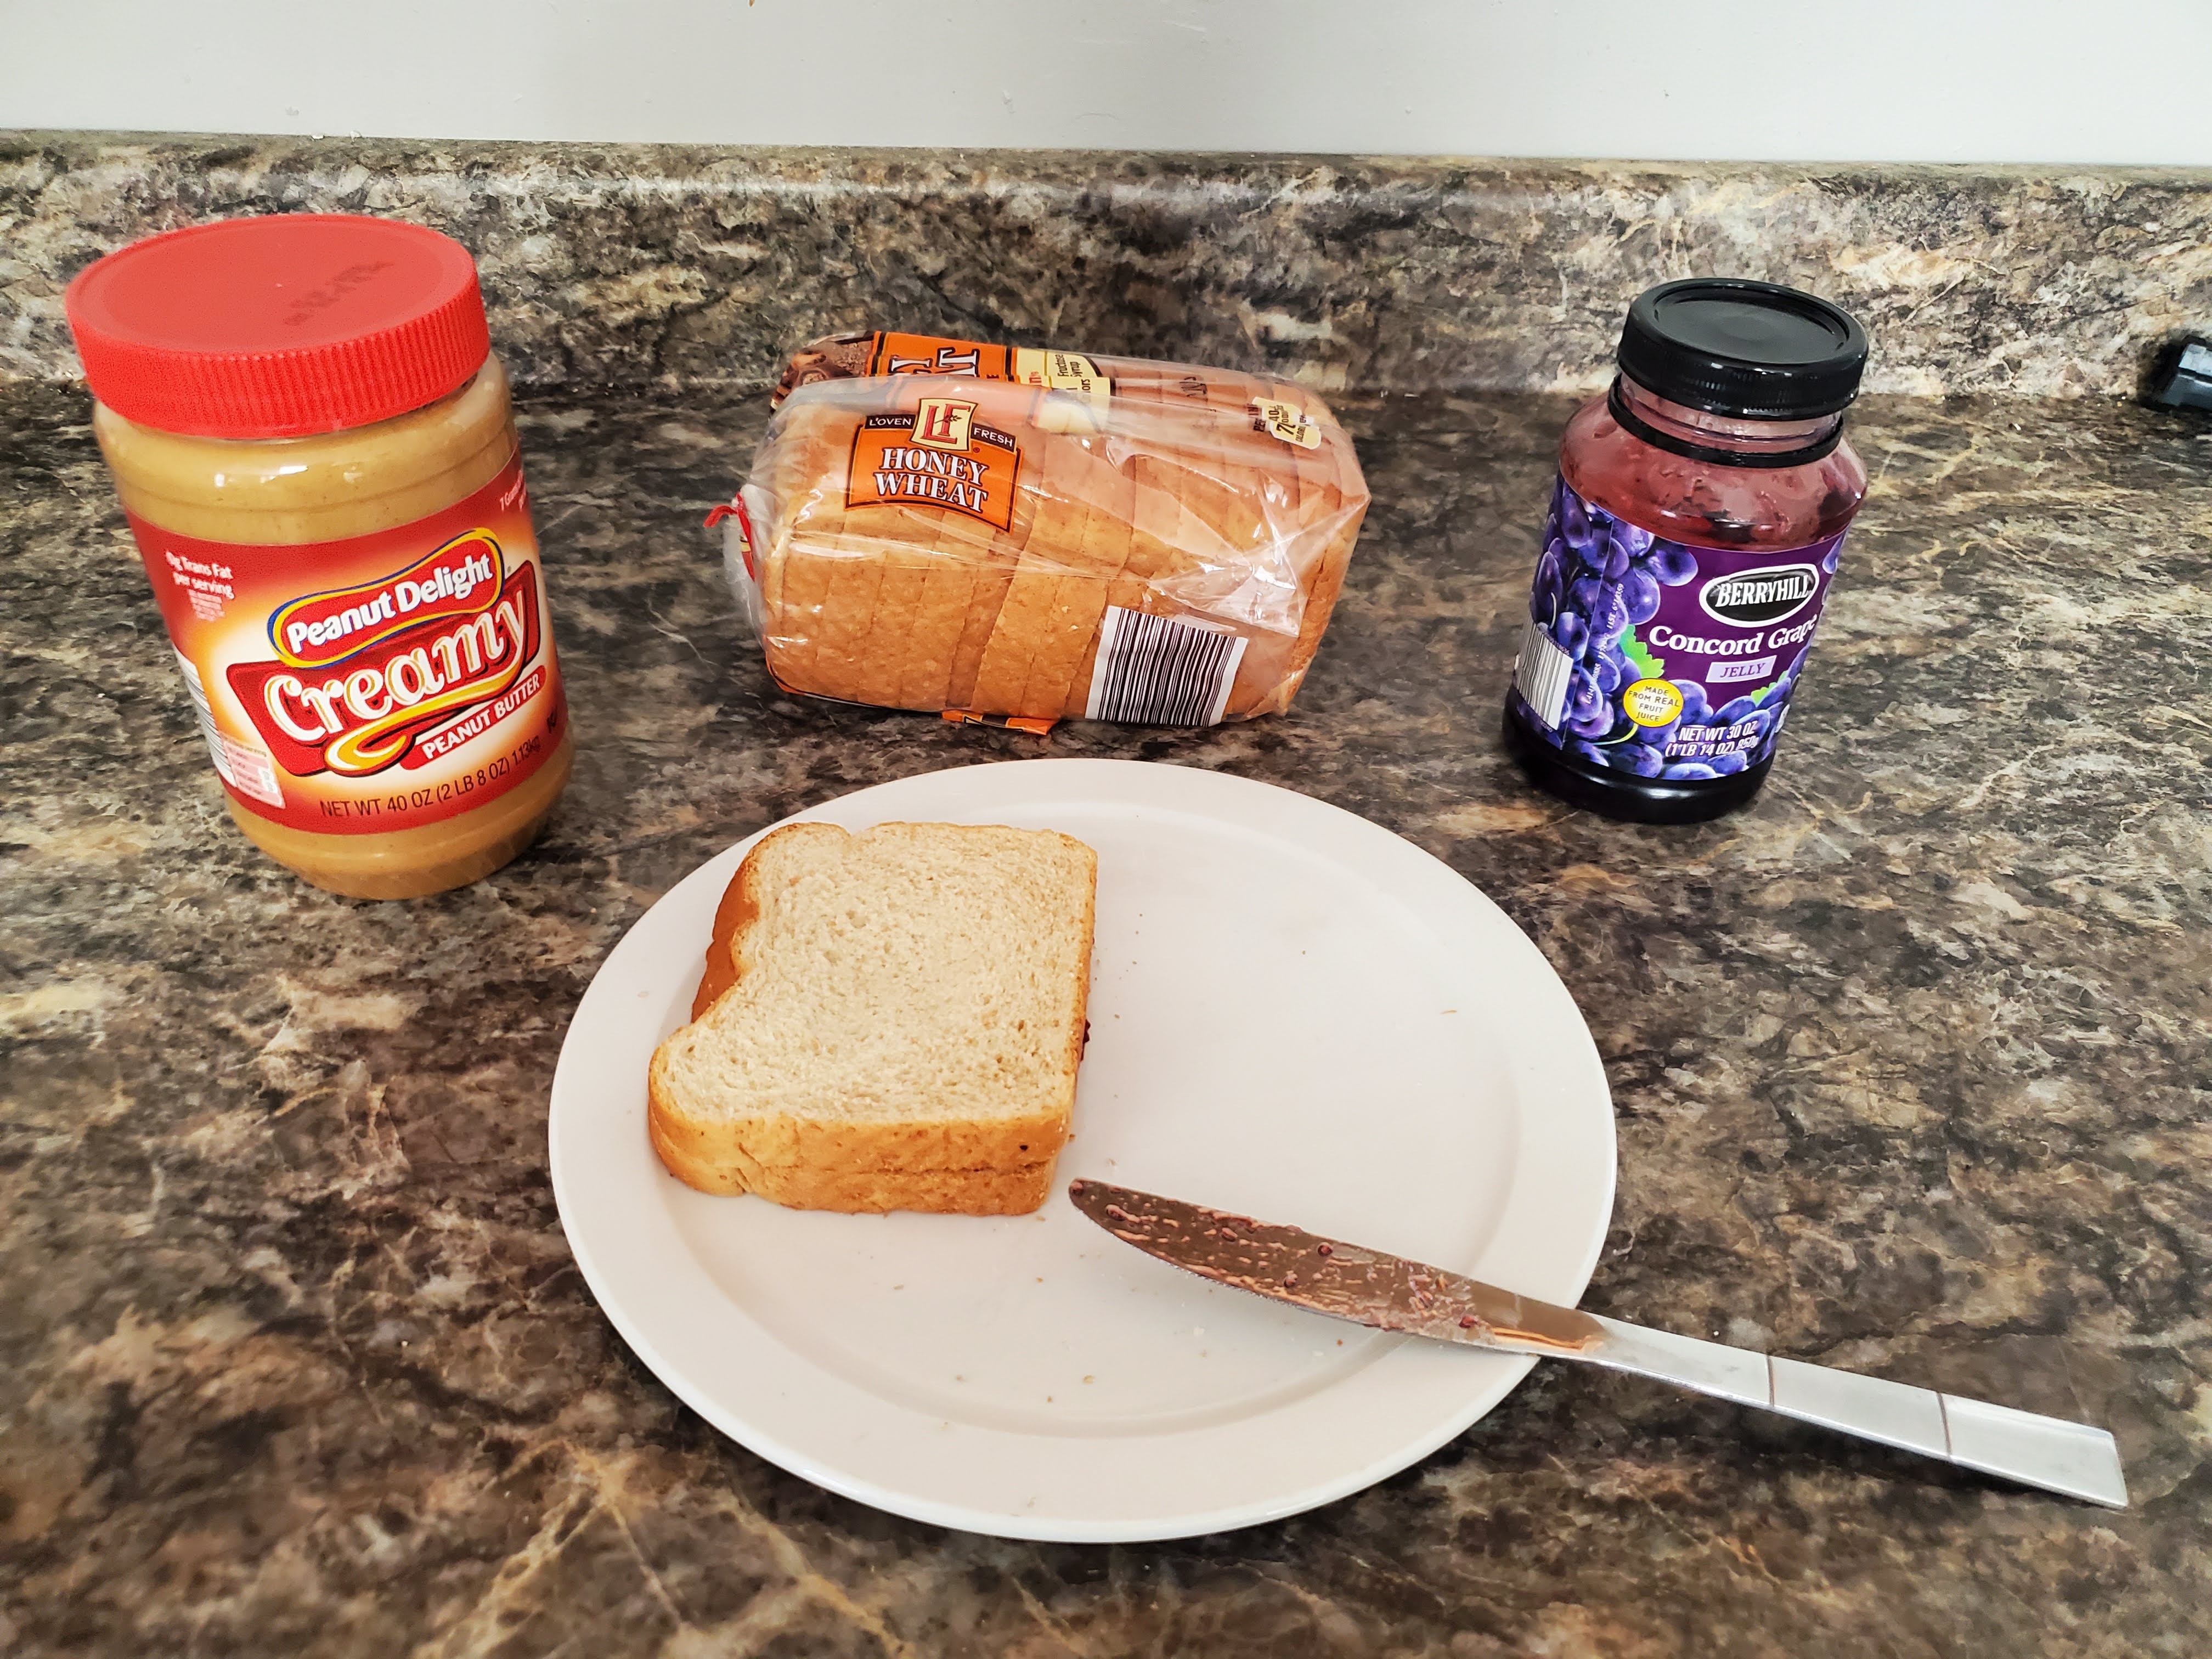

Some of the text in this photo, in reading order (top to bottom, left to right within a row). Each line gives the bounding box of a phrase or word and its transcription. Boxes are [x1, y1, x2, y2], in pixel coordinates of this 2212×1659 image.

[869, 417, 912, 426] L'OVEN
[973, 427, 1013, 447] FRESH
[879, 448, 989, 487] HONEY
[873, 472, 989, 513] WHEAT
[211, 563, 234, 579] Fat
[190, 578, 235, 600] serving
[1715, 574, 1812, 608] BERRYHILL
[286, 591, 396, 654] Peanut
[394, 553, 494, 613] Delight
[1649, 625, 1765, 656] Concord
[1768, 613, 1818, 649] Grape
[264, 590, 526, 742] Creamy
[1720, 662, 1767, 679] JELLY
[1628, 690, 1680, 708] FROM REAL
[1645, 686, 1669, 696] MADE
[422, 708, 490, 759] PEANUT
[495, 673, 541, 719] BUTTER
[1635, 712, 1660, 722] JUICE
[1639, 703, 1664, 713] FRUIT
[1678, 720, 1758, 741] NET WT 30 OZ
[1680, 743, 1697, 757] LB
[1700, 743, 1715, 756] 14
[1716, 741, 1735, 755] OZ)
[320, 800, 351, 817] NET
[354, 798, 381, 816] WT
[387, 794, 407, 812] 40
[411, 788, 434, 808] OZ
[436, 783, 452, 804] (2
[454, 776, 475, 796] LB
[478, 769, 487, 786] 8
[489, 757, 511, 780] OZ)
